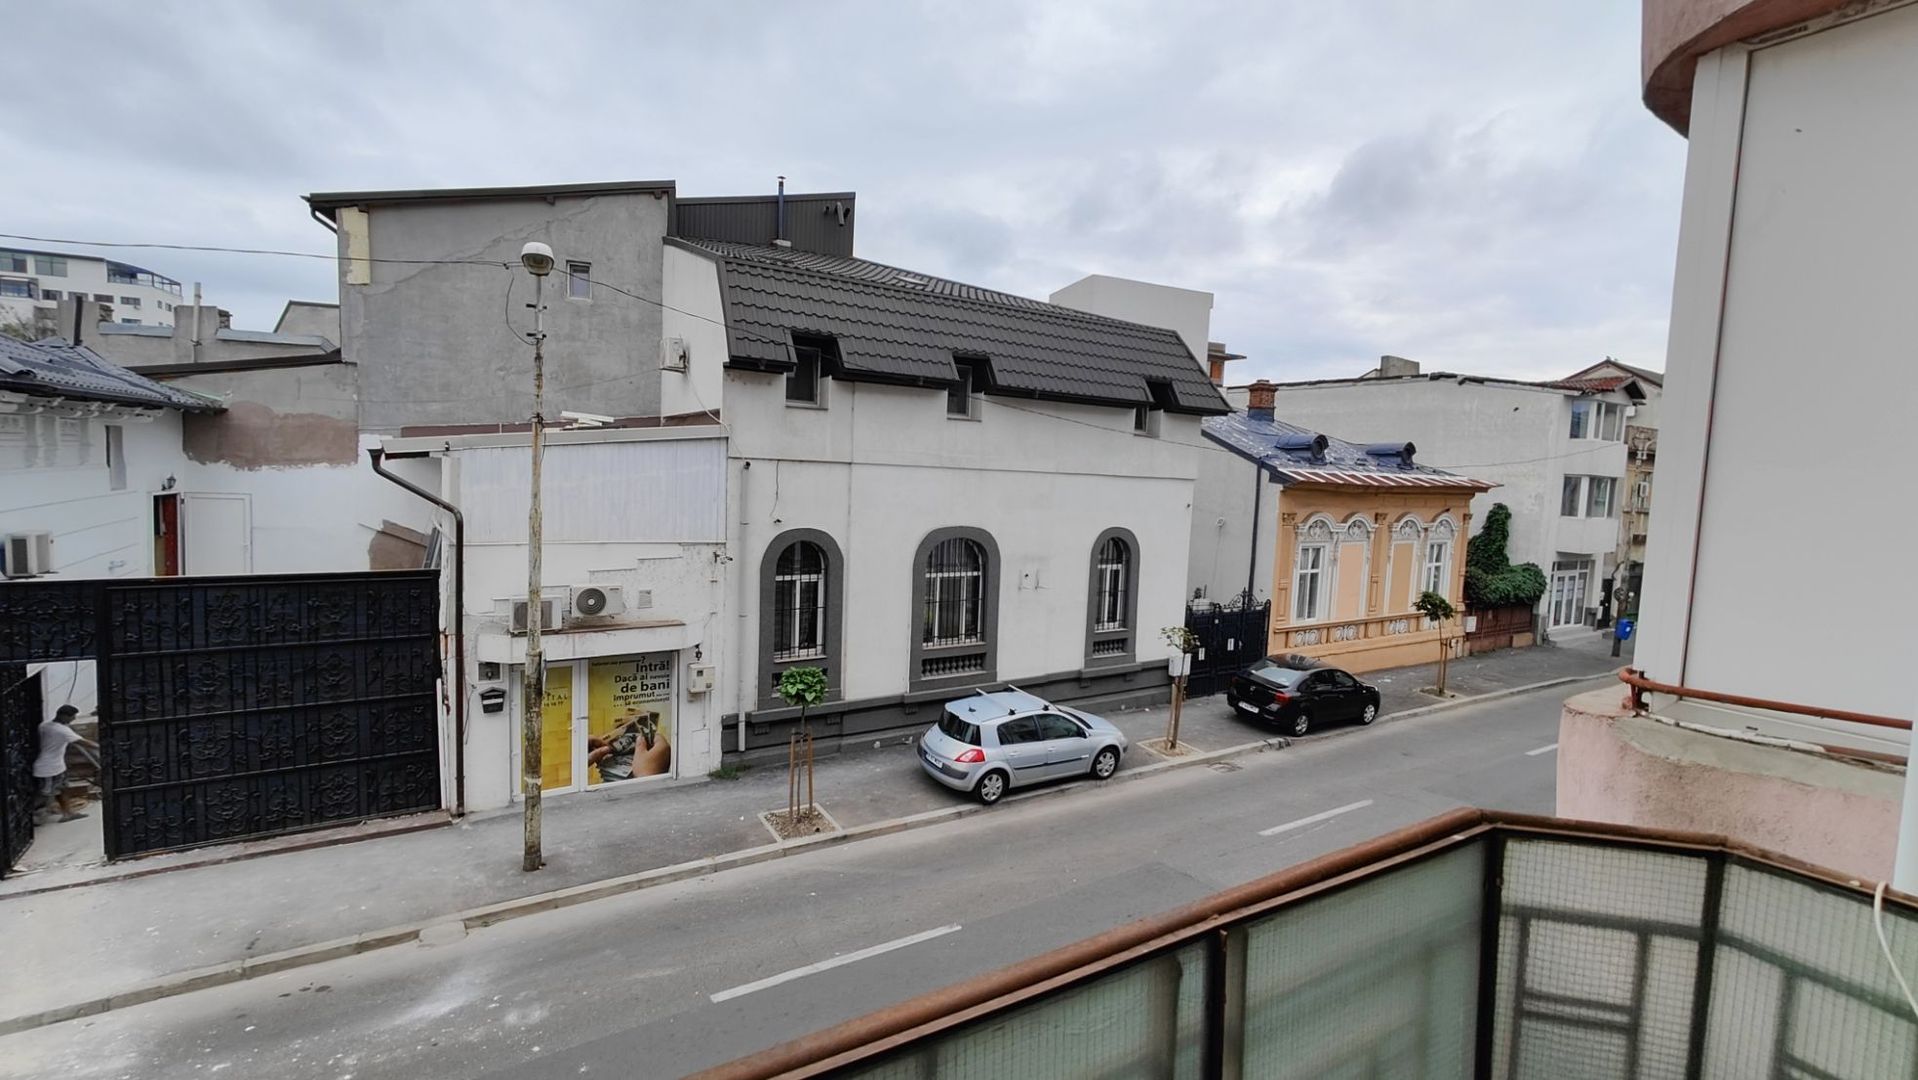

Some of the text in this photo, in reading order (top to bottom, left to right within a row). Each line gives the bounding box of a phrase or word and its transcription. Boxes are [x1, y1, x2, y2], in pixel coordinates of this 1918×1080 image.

[614, 673, 638, 684] Dacă
[621, 679, 670, 694] de bani
